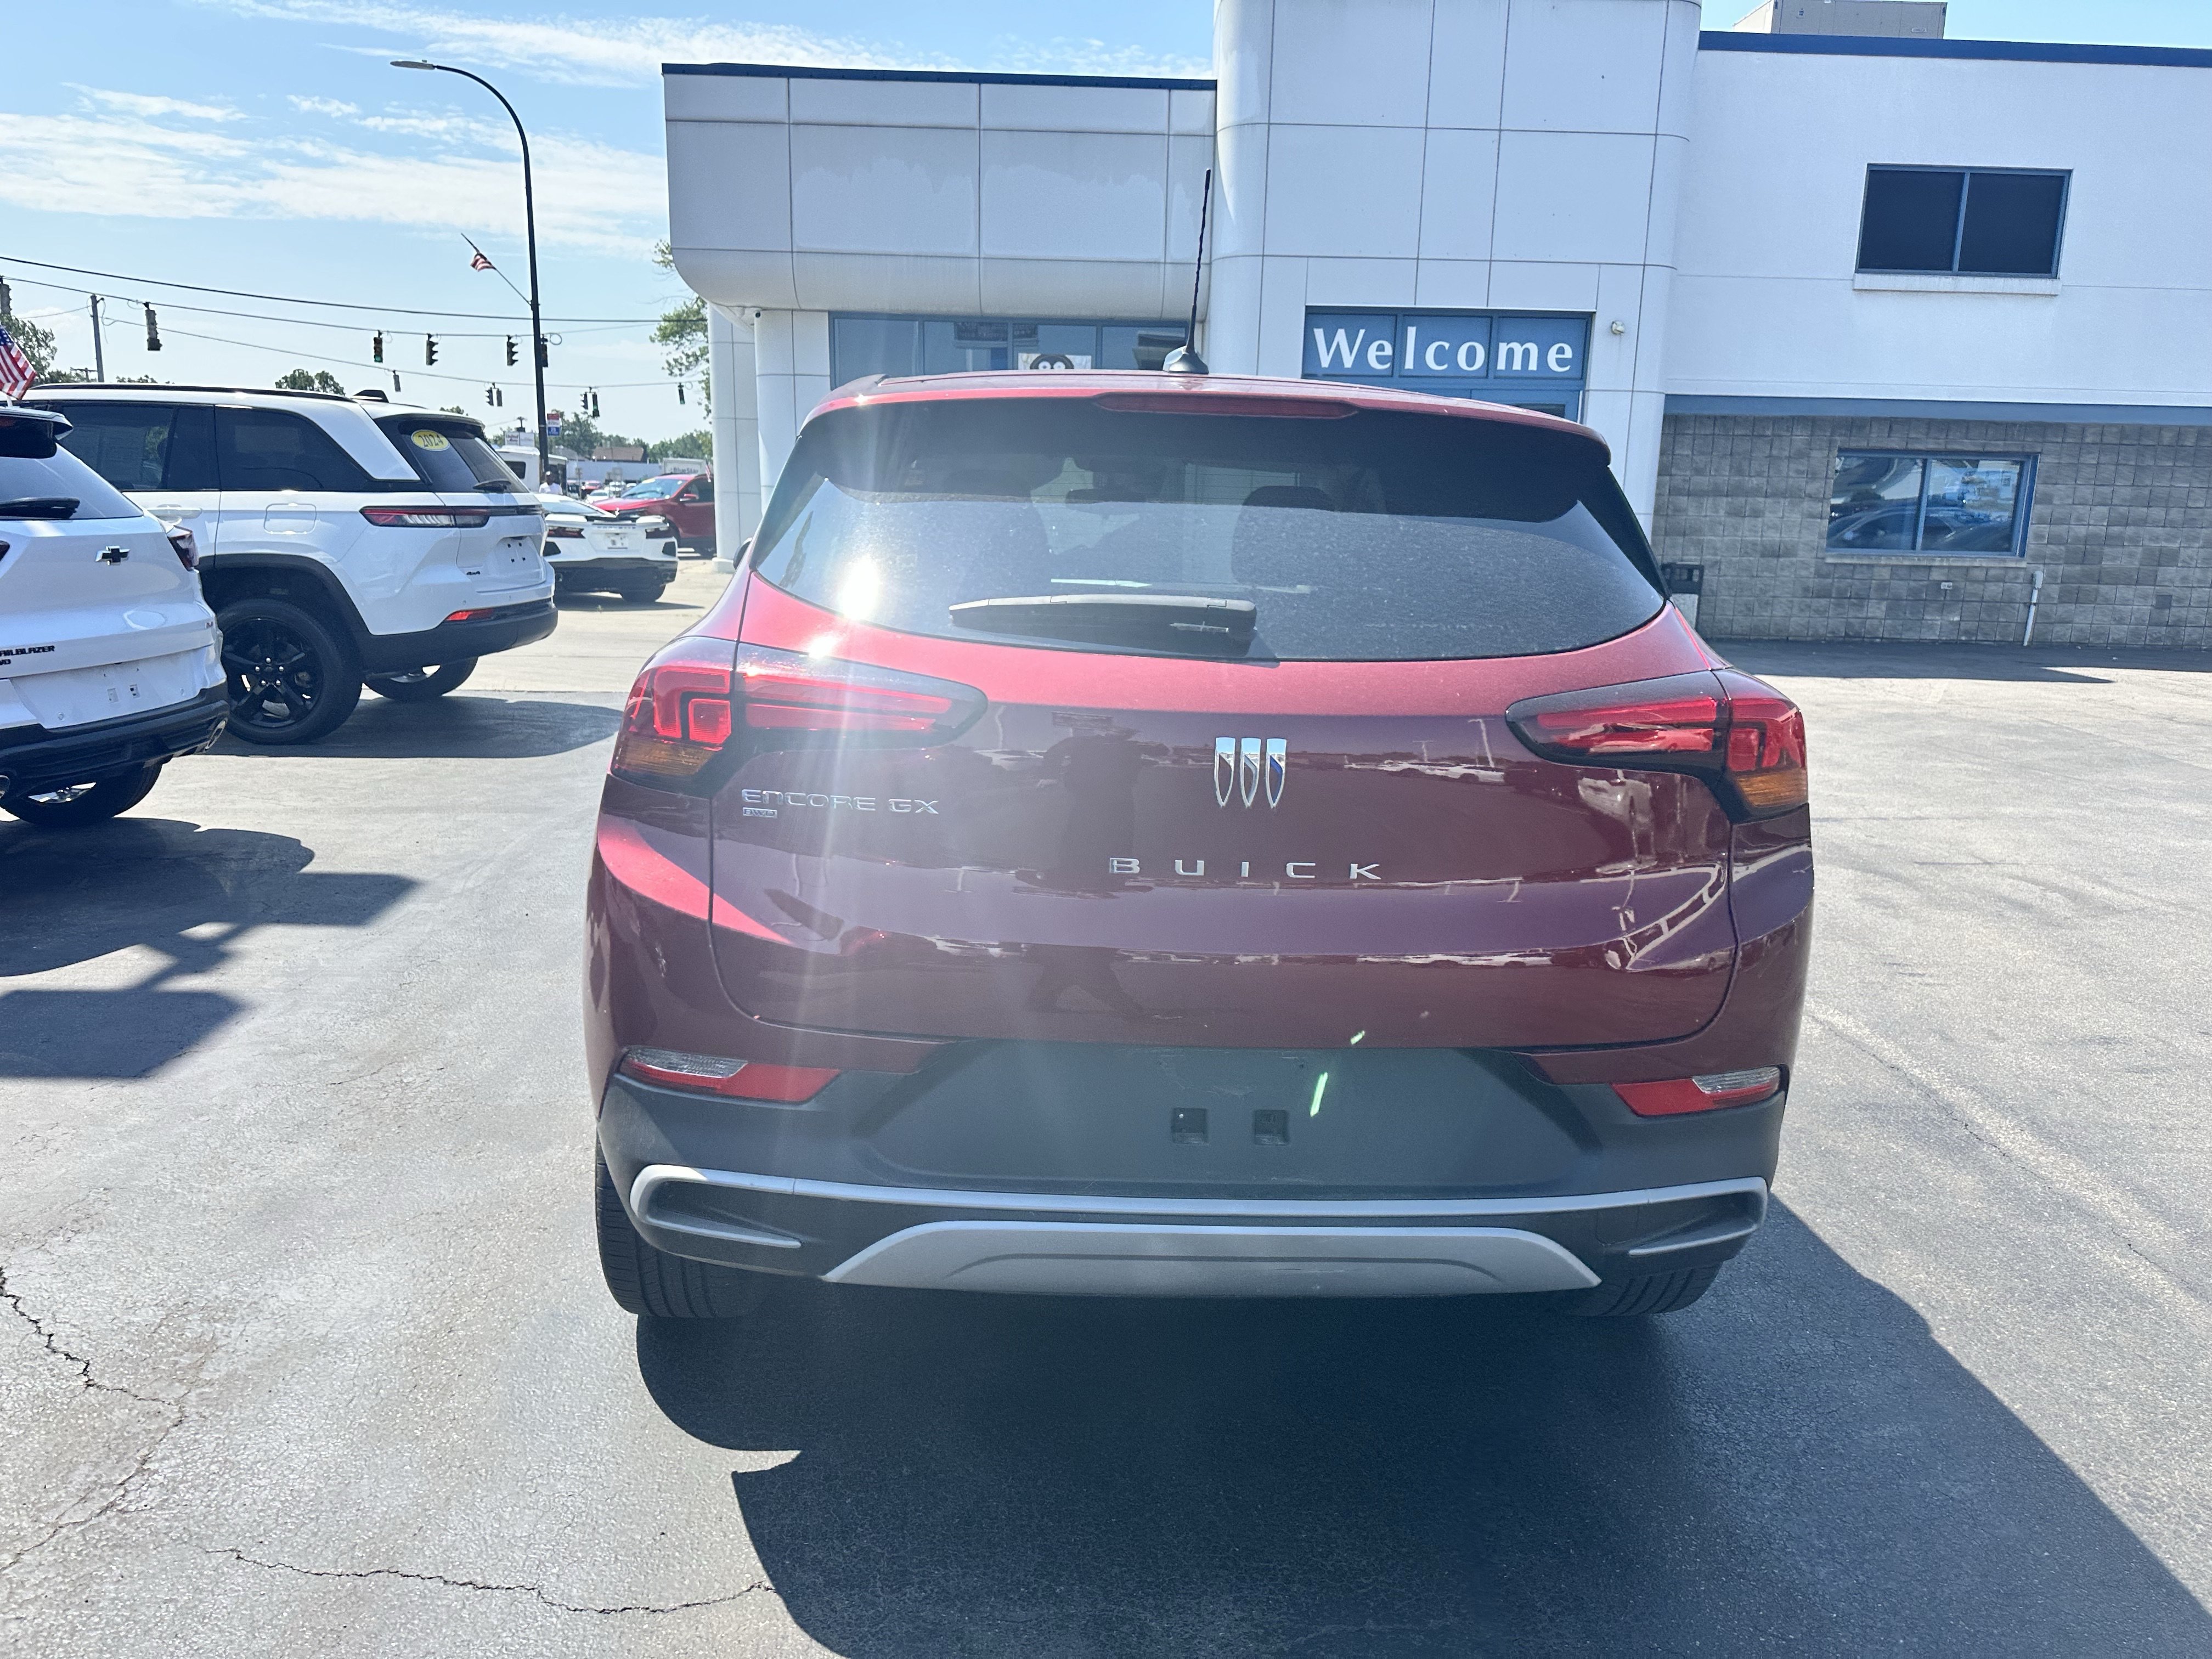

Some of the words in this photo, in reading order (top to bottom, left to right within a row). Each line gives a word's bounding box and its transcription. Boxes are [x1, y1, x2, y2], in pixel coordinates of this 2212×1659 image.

[1313, 326, 1573, 373] Welcome
[419, 434, 444, 447] 2024
[742, 789, 876, 811] ENCORE
[888, 798, 939, 815] GX
[1109, 857, 1382, 880] BUICK
